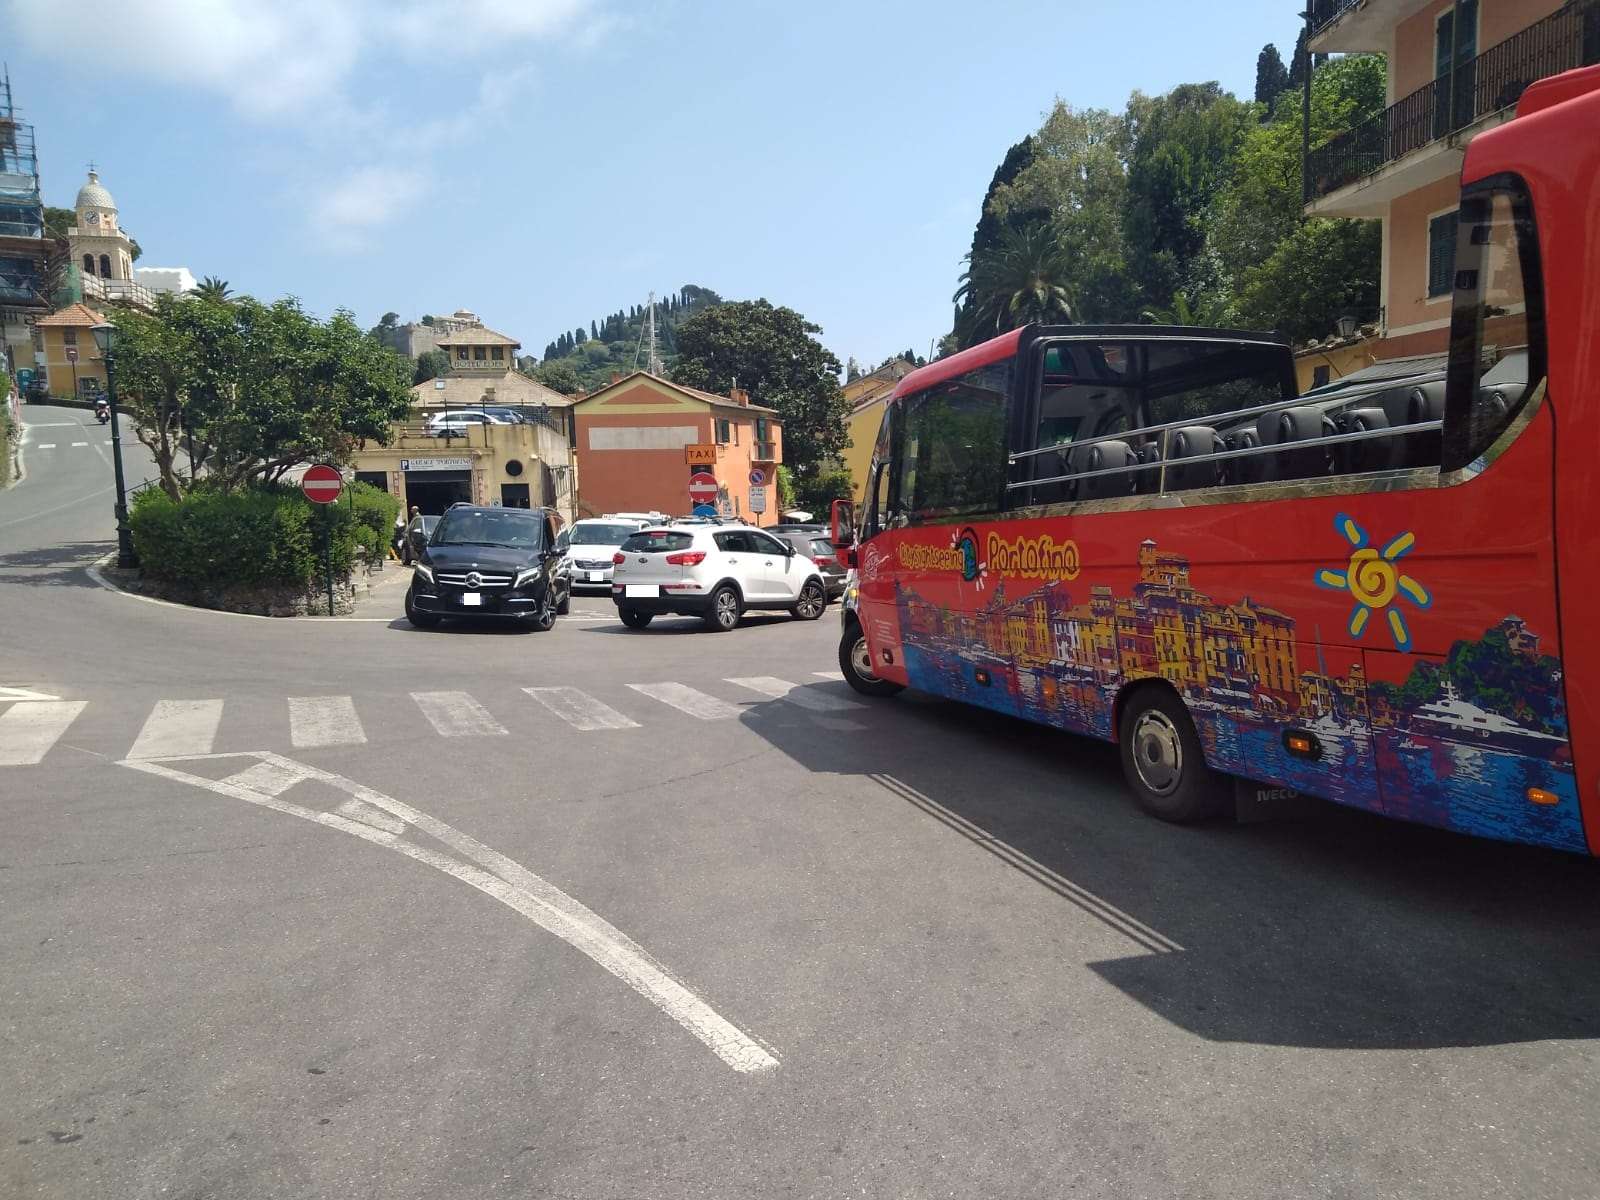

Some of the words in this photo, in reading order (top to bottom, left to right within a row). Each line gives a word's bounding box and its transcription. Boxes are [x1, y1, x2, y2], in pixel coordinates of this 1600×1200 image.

[454, 360, 480, 368] HOTEL
[688, 450, 714, 458] TAXI
[988, 531, 1080, 580] Portofino
[1256, 789, 1298, 802] IVECO
